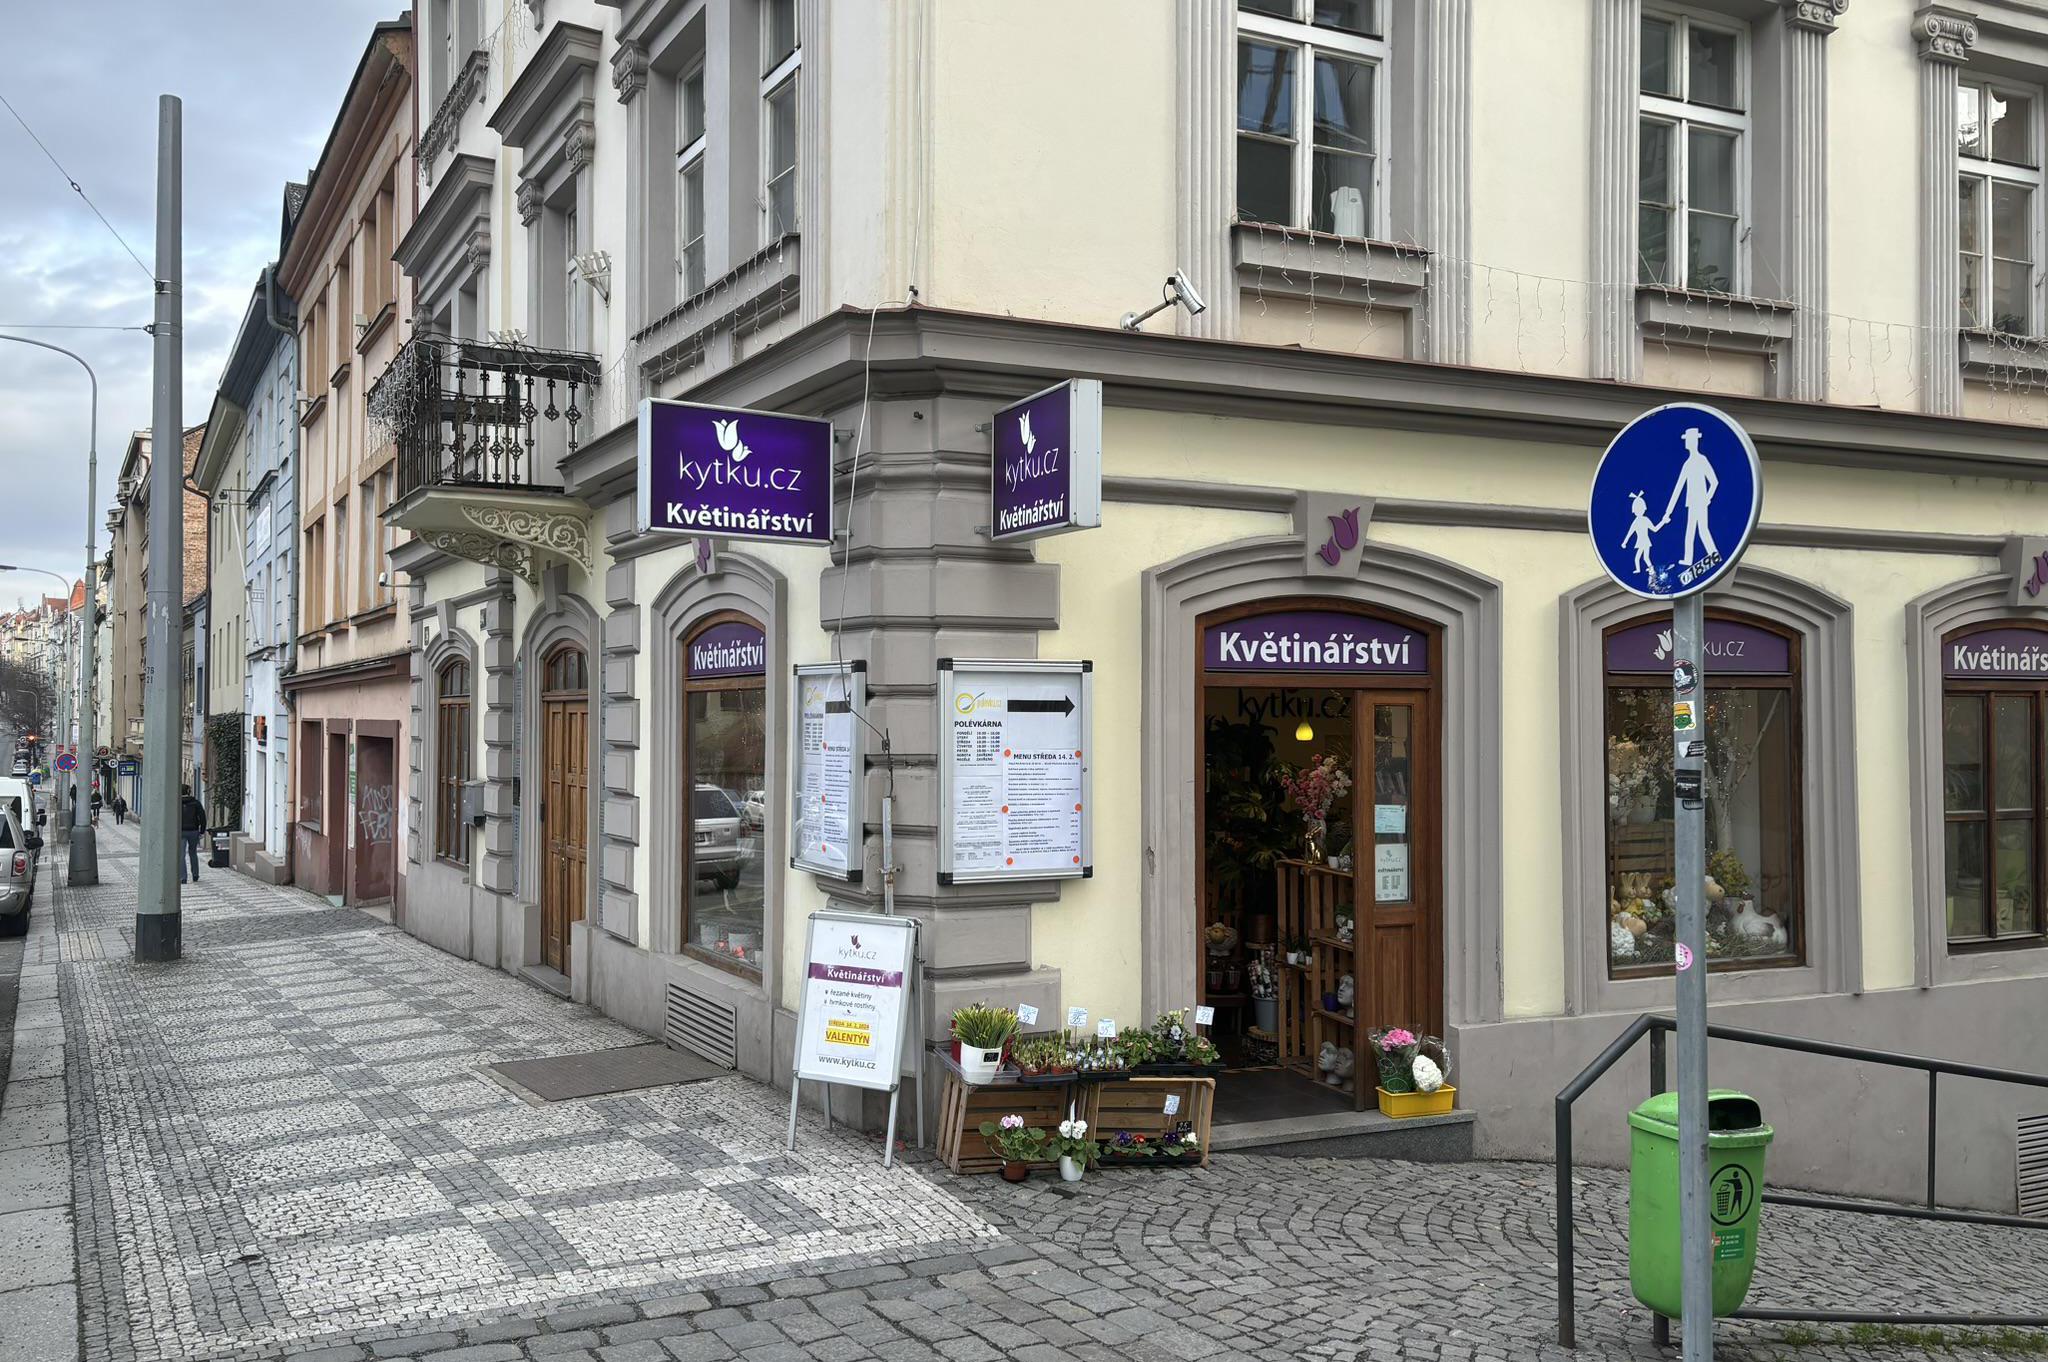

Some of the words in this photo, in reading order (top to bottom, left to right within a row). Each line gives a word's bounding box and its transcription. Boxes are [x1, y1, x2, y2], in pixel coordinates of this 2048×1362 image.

[679, 450, 802, 491] kytku.cz
[1005, 447, 1059, 493] kytku.cz
[667, 502, 814, 533] Květinářství
[1000, 493, 1064, 531] Květinářství
[694, 636, 764, 671] Květinářství
[1219, 631, 1412, 665] Květinářství
[954, 719, 1003, 728] POLÉVKÁRNA
[838, 946, 877, 960] kytku.cz
[827, 968, 885, 983] Květinářství
[826, 1030, 870, 1044] VALENTÝN
[818, 1056, 876, 1070] www.kytku.cz
